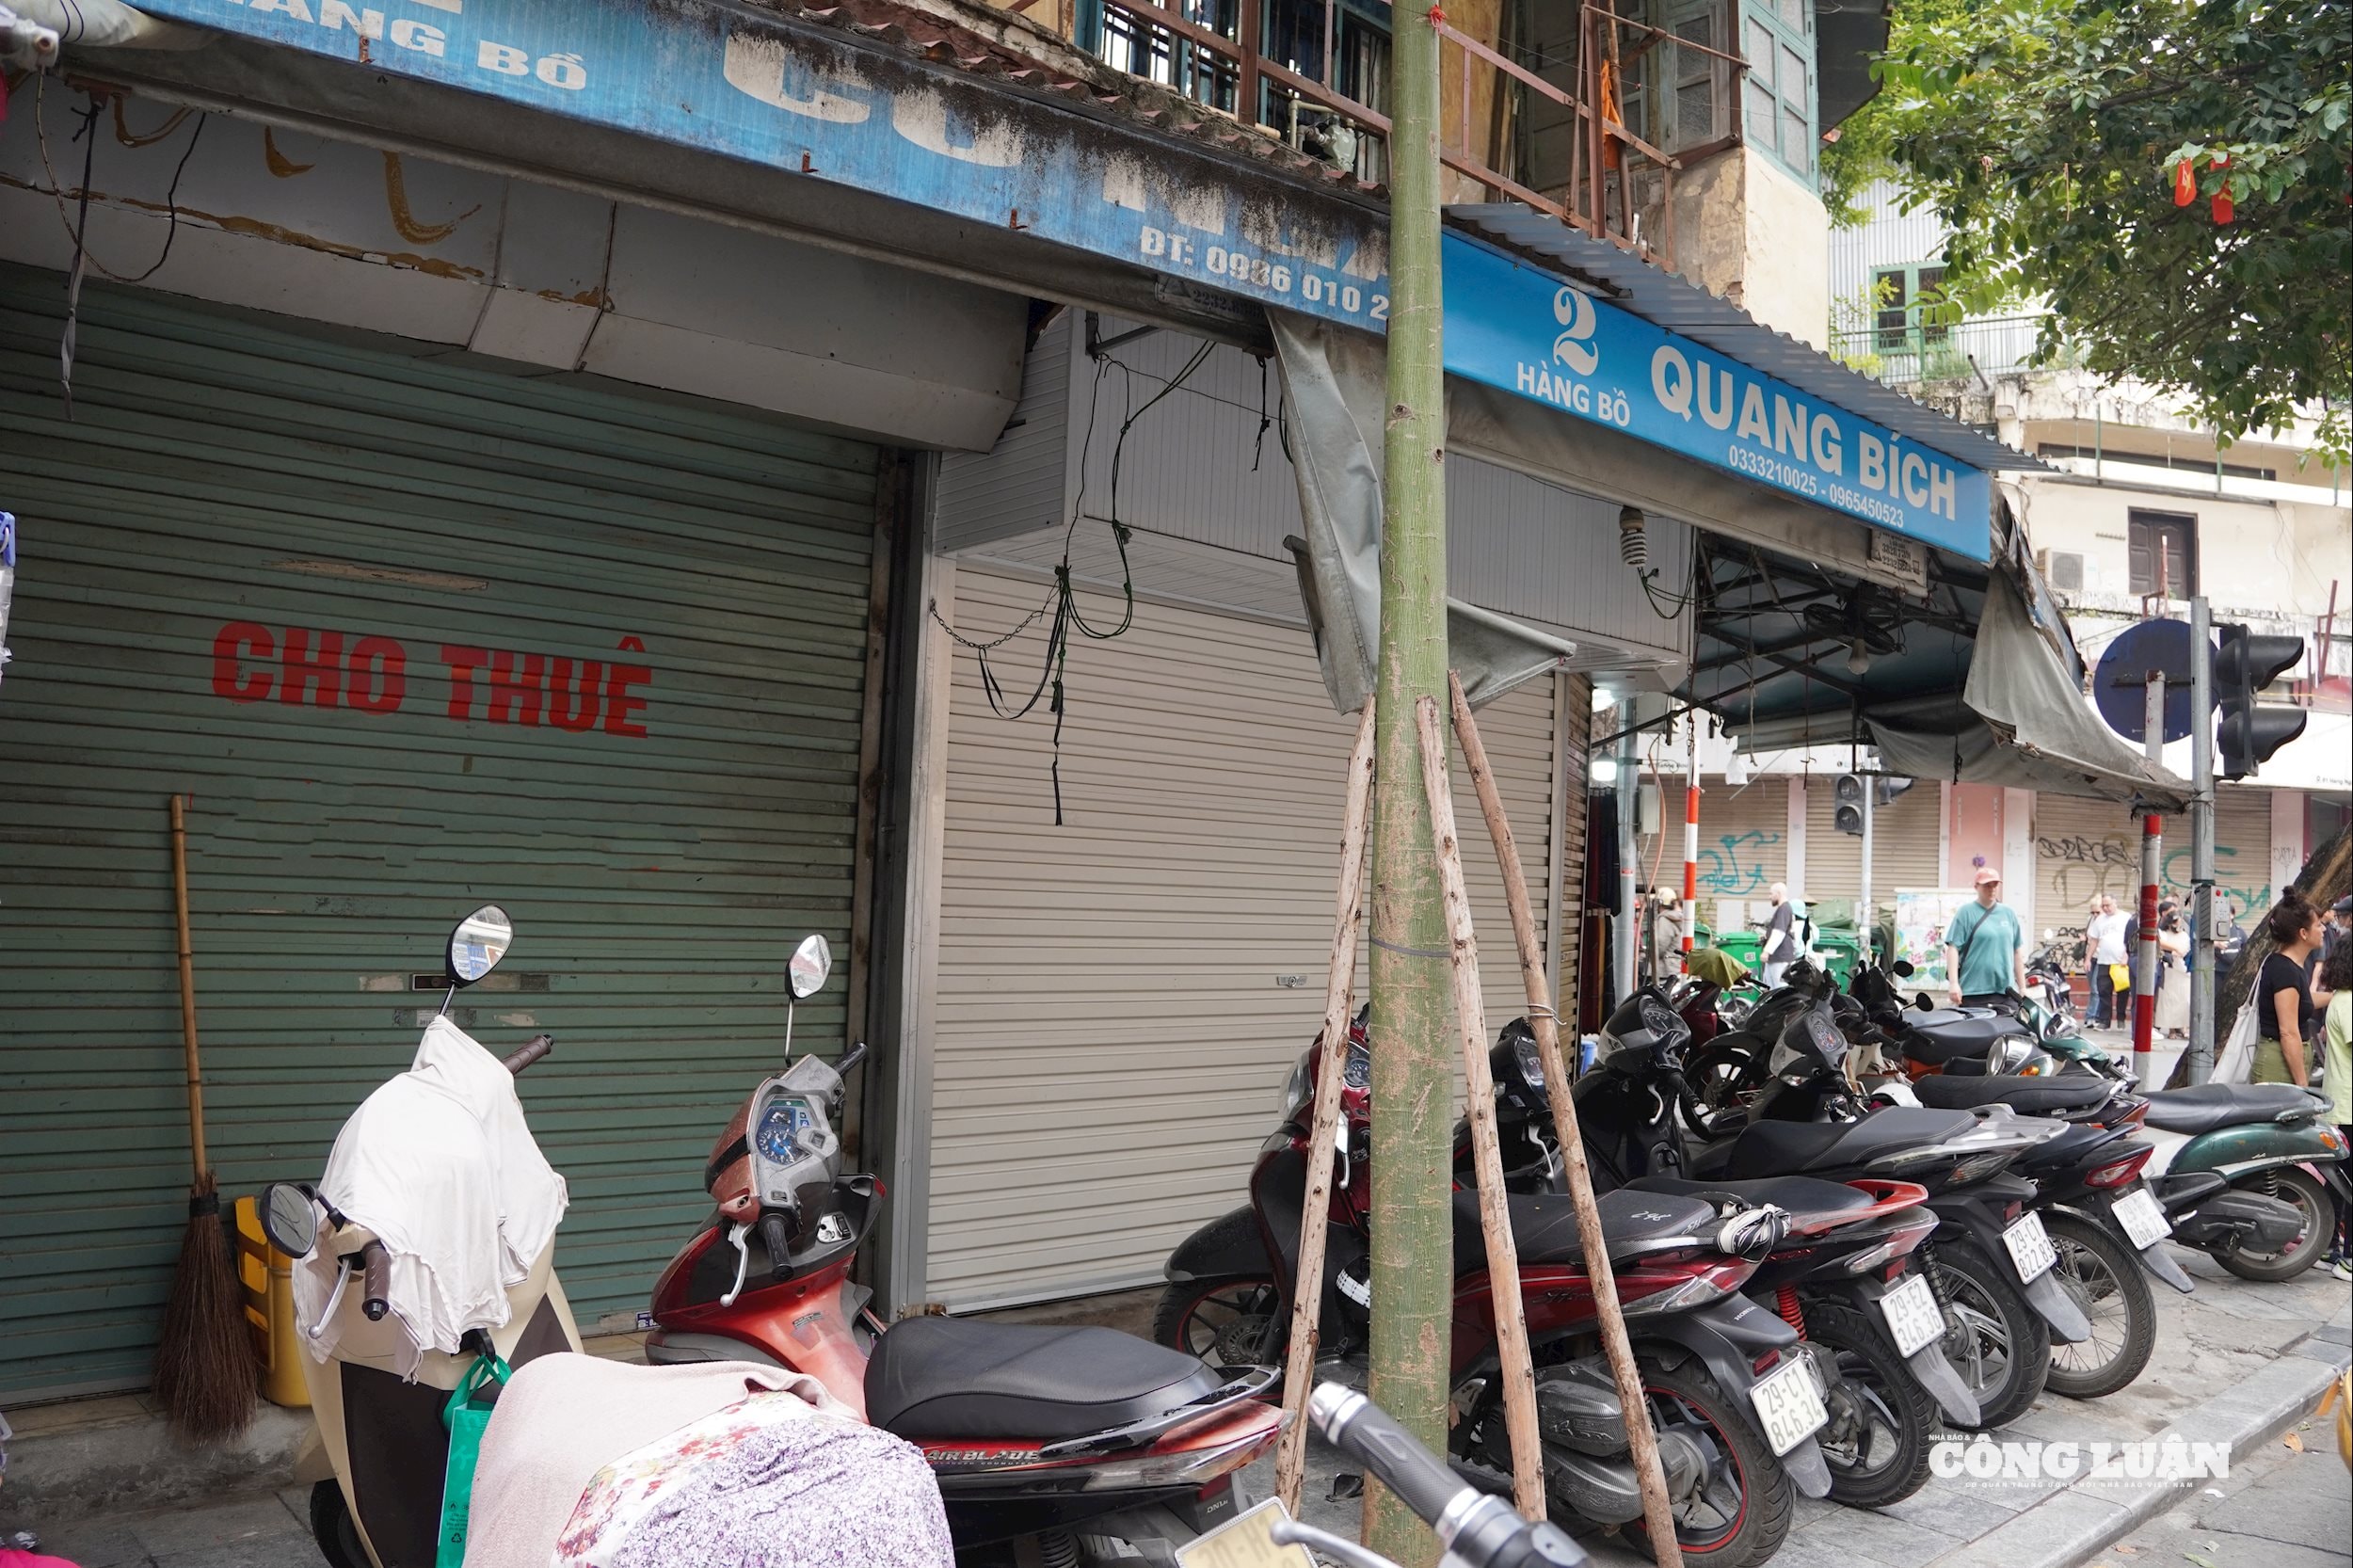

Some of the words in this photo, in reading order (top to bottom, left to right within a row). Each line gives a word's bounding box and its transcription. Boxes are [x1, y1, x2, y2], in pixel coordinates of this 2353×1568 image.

[1140, 225, 1193, 266] ĐT:
[1302, 274, 1361, 312] 010
[1554, 285, 1599, 376] 2
[1517, 360, 1590, 414] HÀNG
[1597, 387, 1631, 427] BỒ
[1650, 344, 1843, 476] QUANG
[1859, 431, 1956, 520] BÍCH
[1728, 444, 1817, 496] 0333210025
[1829, 483, 1904, 528] 0965450523
[212, 620, 407, 715] CHO
[440, 636, 652, 739] THUÊ
[2010, 1219, 2041, 1253] 29-C1
[2018, 1239, 2053, 1277] 822.83
[1890, 1282, 1928, 1322] 29-E2
[1897, 1306, 1942, 1351] 346.36
[1762, 1368, 1805, 1415] 29-C1
[1770, 1395, 1823, 1448] 846.34
[926, 1450, 961, 1461] AIR
